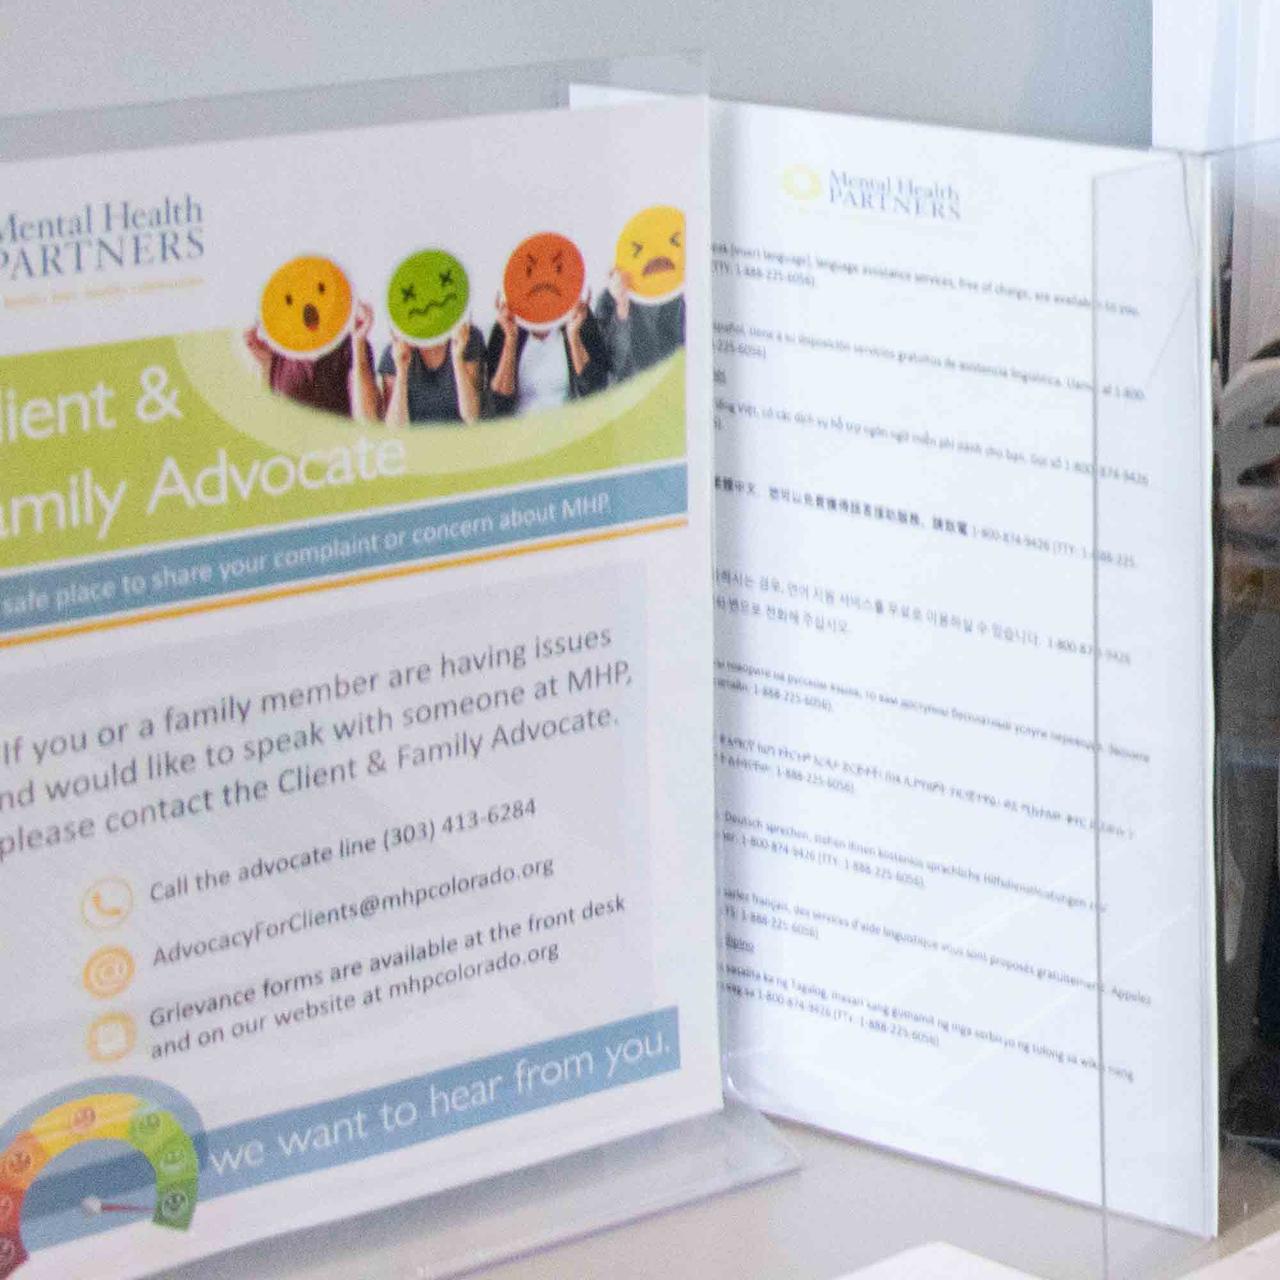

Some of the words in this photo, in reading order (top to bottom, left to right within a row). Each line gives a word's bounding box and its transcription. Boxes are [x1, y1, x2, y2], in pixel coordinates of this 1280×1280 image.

[104, 193, 202, 233] Health
[135, 361, 188, 424] &
[0, 467, 127, 541] mily
[148, 430, 406, 512] Advocate
[2, 587, 49, 617] safe
[55, 580, 116, 612] place
[122, 574, 146, 597] to
[151, 564, 212, 591] share
[218, 554, 267, 584] your
[273, 533, 379, 570] complaint
[384, 530, 406, 551] or
[412, 515, 494, 547] concern
[499, 502, 556, 531] about
[4, 736, 22, 767] If
[33, 731, 87, 765] you
[97, 722, 128, 748] or
[139, 718, 154, 740] a
[164, 695, 251, 734] family
[261, 673, 379, 715] member
[389, 663, 431, 690] are
[441, 644, 526, 679] having
[535, 629, 611, 660] issues
[45, 756, 137, 802] would
[147, 750, 196, 781] like
[206, 744, 234, 769] to
[244, 721, 324, 764] speak
[333, 708, 392, 742] with
[403, 686, 525, 727] someone
[534, 675, 557, 701] at
[568, 660, 631, 694] MHP,
[0, 818, 94, 863] please
[105, 788, 213, 834] contact
[222, 778, 268, 808] the
[278, 757, 356, 795] Client
[367, 749, 386, 776] &
[398, 731, 483, 769] Family
[491, 708, 617, 751] Advocate.
[150, 875, 188, 903] Call
[195, 869, 230, 892] the
[239, 846, 332, 882] advocate
[339, 837, 376, 859] line
[383, 820, 435, 853] (303)
[442, 797, 535, 834] 413-6284
[150, 987, 255, 1028] Grievance
[262, 970, 323, 999] forms
[330, 961, 363, 983] are
[370, 936, 458, 973] available
[465, 930, 483, 950] at
[489, 922, 521, 943] the
[528, 907, 574, 933] front
[582, 894, 624, 921] desk
[153, 858, 554, 967] AdvocacyForClients@mhpcolorado.org
[151, 1029, 190, 1060] and
[197, 1027, 224, 1048] on
[231, 1016, 265, 1039] our
[274, 994, 355, 1027] website
[363, 985, 382, 1007] at
[389, 943, 559, 999] mhpcolorado.org
[210, 1139, 264, 1178] we
[277, 1110, 369, 1159] want
[379, 1101, 417, 1136] to
[430, 1074, 503, 1120] hear
[513, 1050, 594, 1098] from
[606, 1022, 674, 1081] you.
